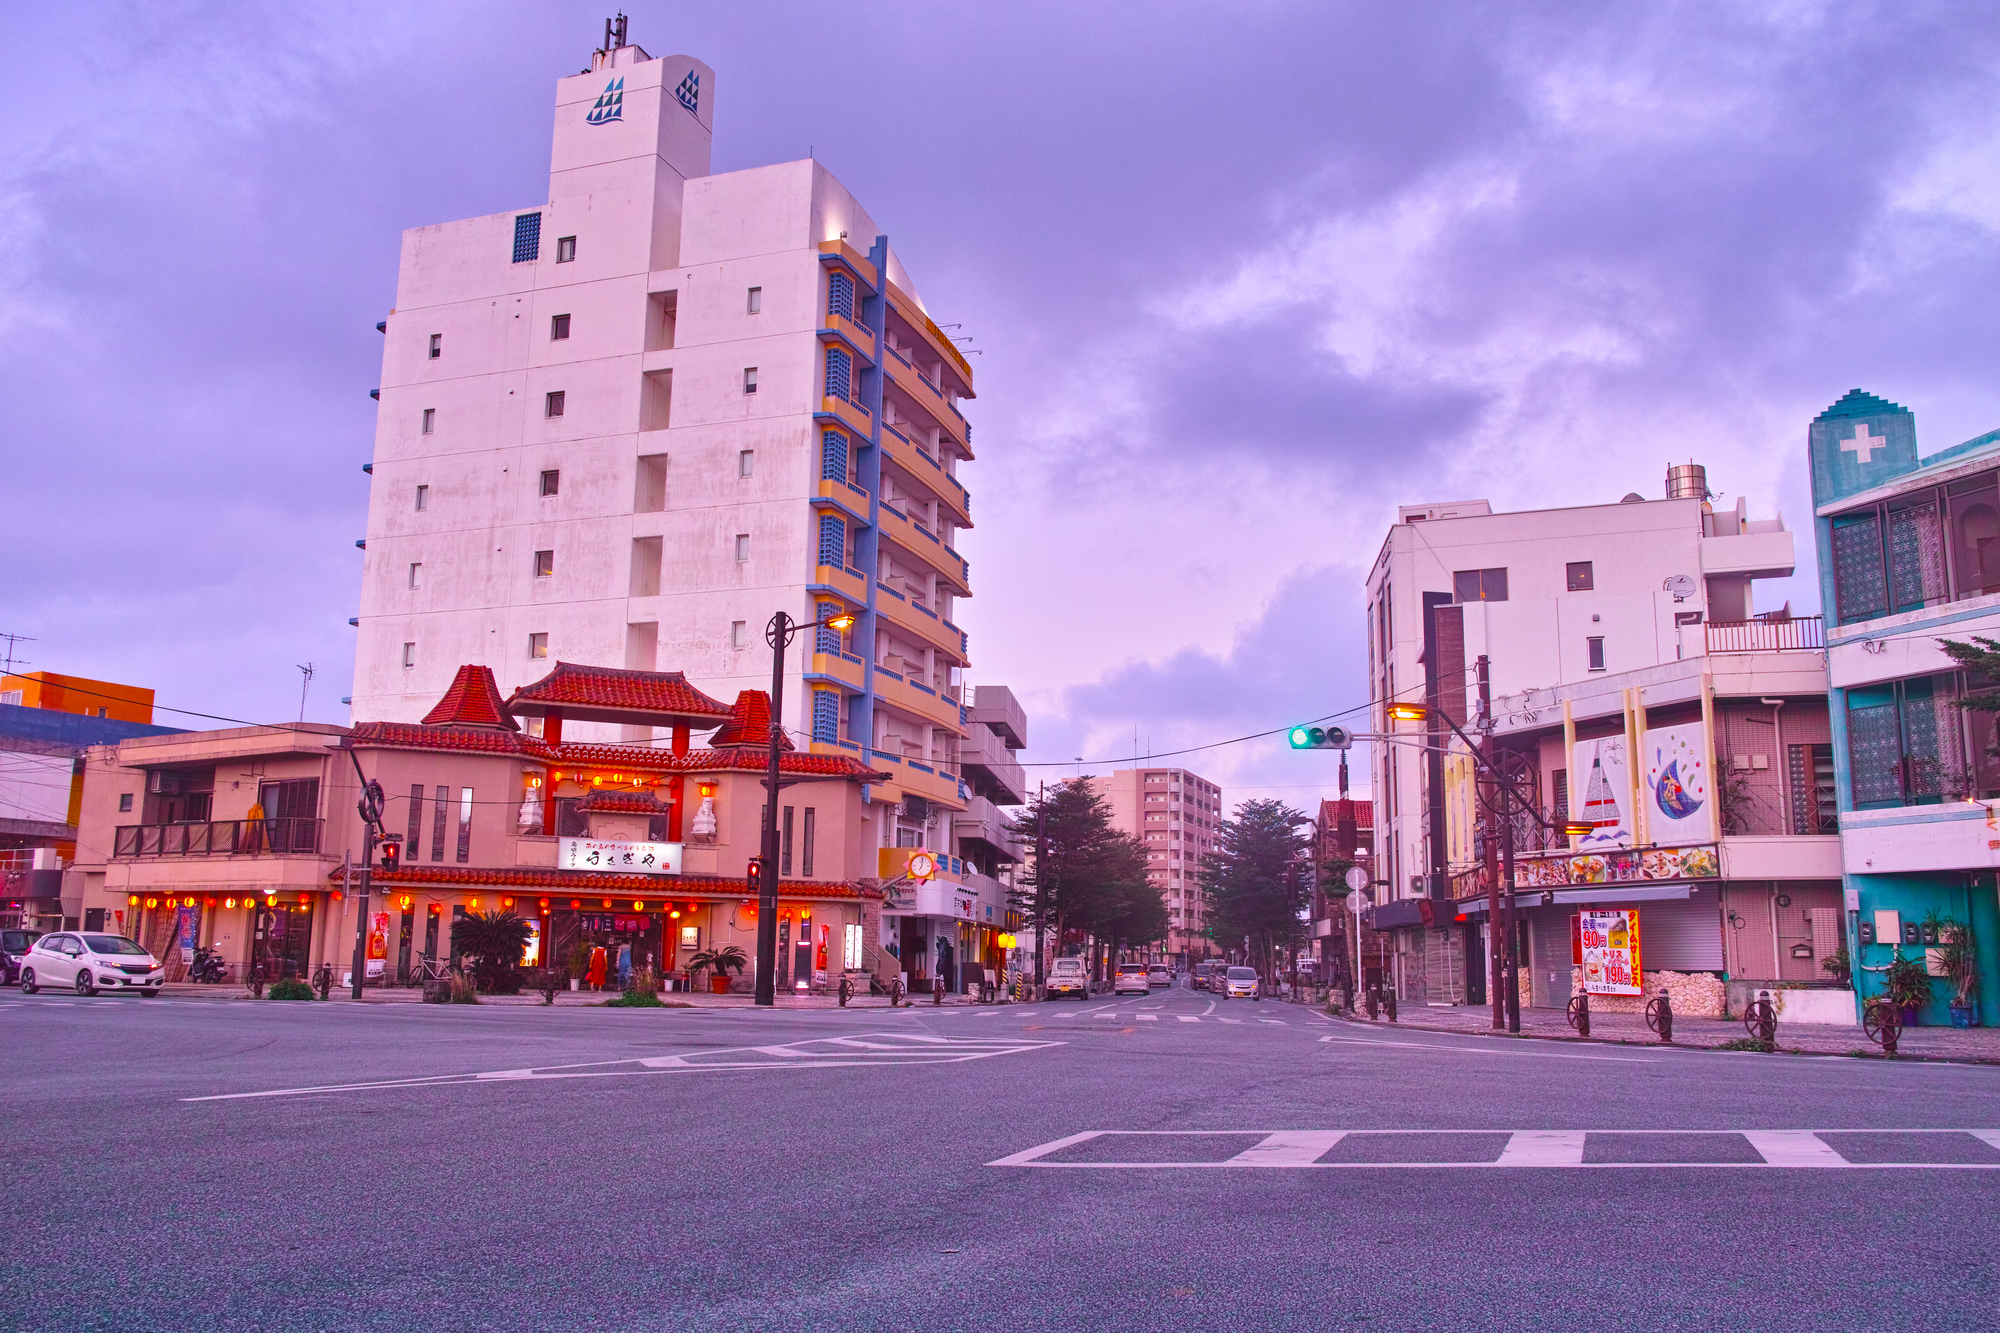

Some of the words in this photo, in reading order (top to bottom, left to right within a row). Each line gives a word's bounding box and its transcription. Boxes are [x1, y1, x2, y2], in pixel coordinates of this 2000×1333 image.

[586, 850, 655, 868] うさぎや
[1583, 929, 1607, 948] 90円
[1602, 950, 1623, 959] トリス
[1628, 911, 1639, 987] タイムサービス
[1604, 965, 1631, 985] 190円
